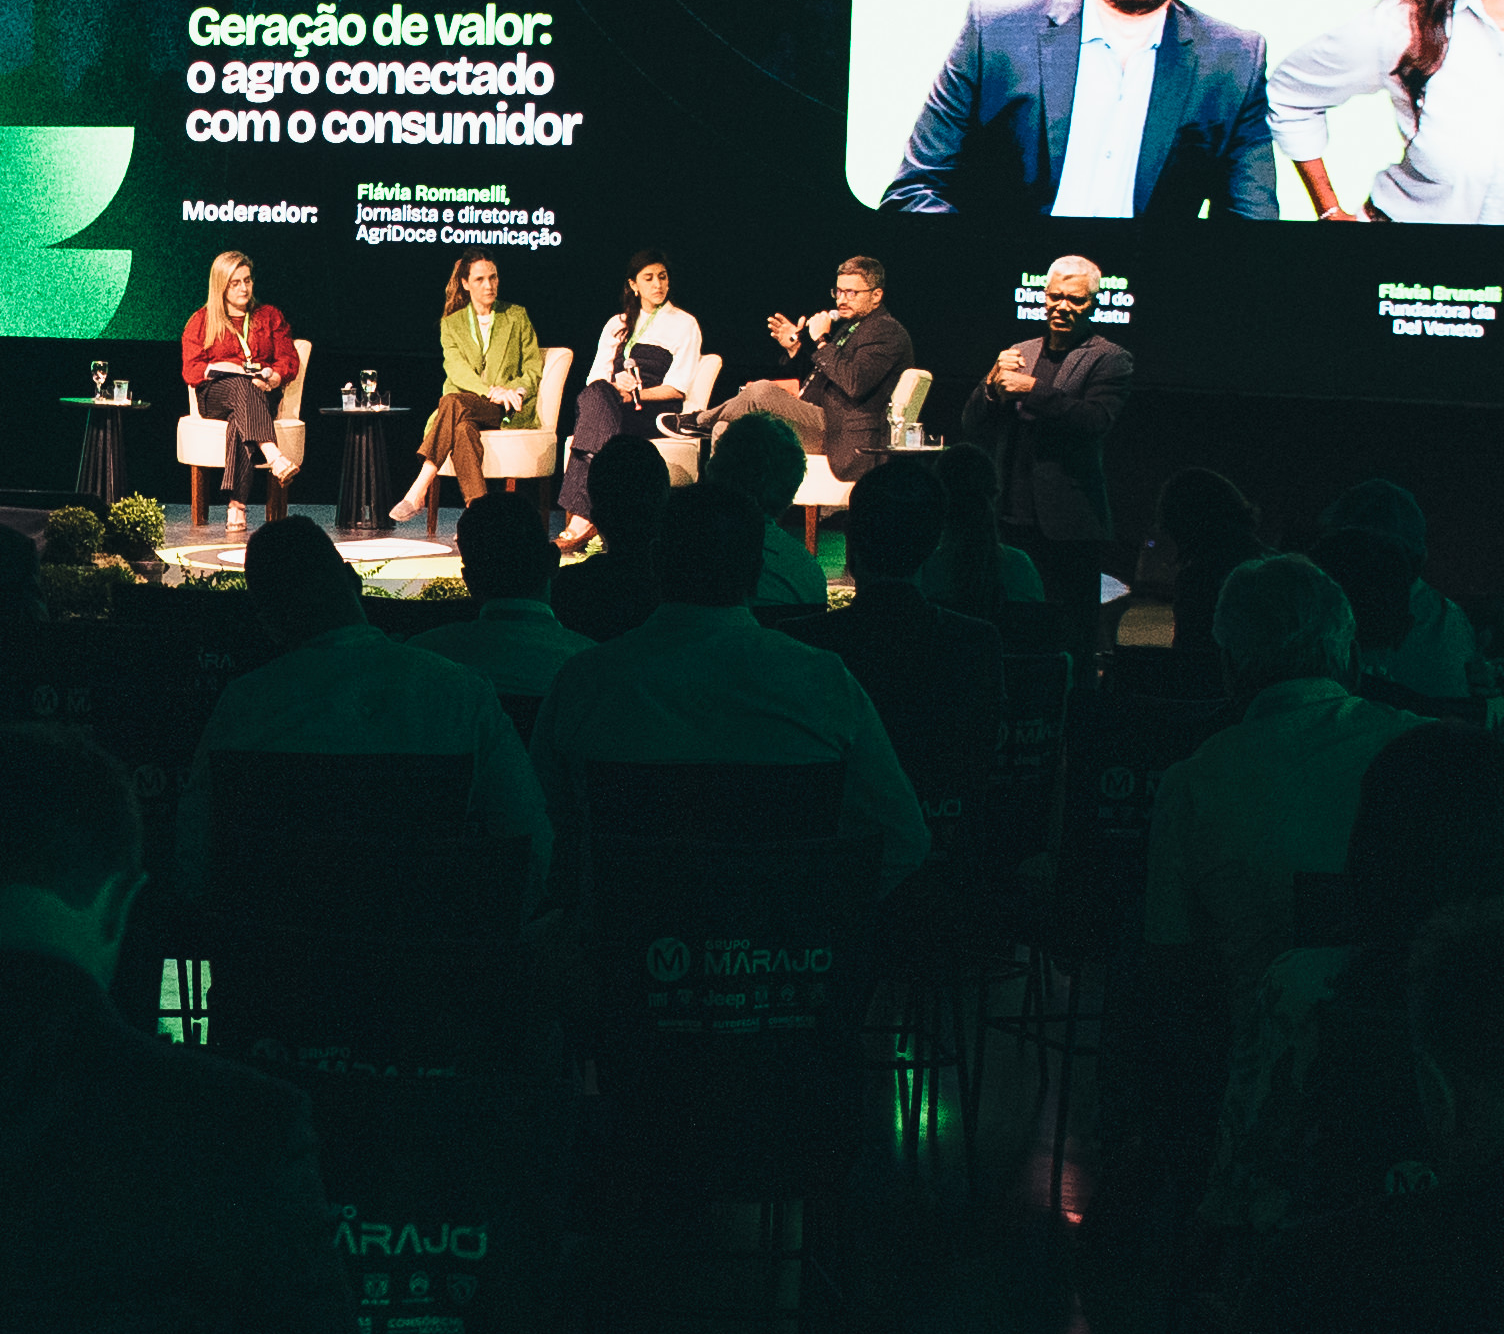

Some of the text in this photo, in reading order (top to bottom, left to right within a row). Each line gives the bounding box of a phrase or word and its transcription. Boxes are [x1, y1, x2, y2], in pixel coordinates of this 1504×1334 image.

[188, 2, 554, 58] Geração de valor:
[186, 52, 555, 103] o agro conectado
[185, 100, 584, 146] com o consumidor
[356, 181, 511, 205] Flávia Romanelli,
[182, 199, 318, 224] Moderador:
[355, 202, 555, 226] jornalista e diretora da
[355, 224, 563, 251] AgriDoce Comunicação
[1378, 300, 1496, 320] Fundadora da
[1392, 318, 1423, 336] Del
